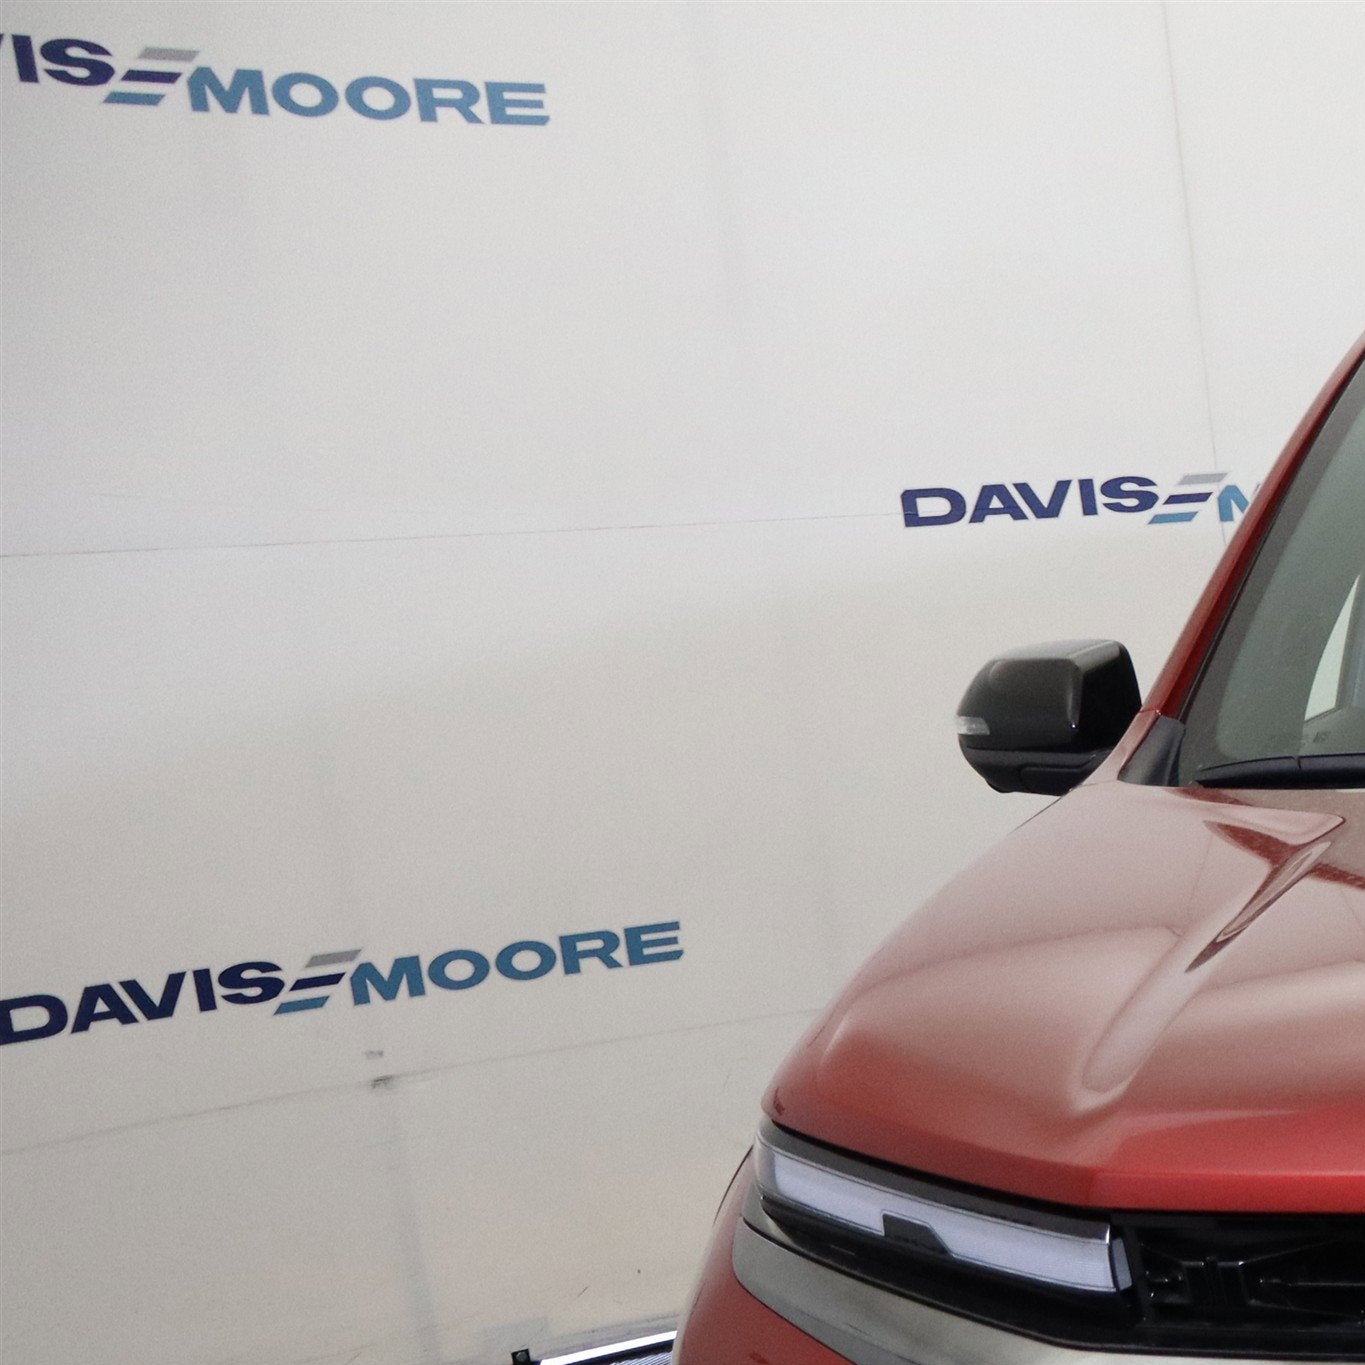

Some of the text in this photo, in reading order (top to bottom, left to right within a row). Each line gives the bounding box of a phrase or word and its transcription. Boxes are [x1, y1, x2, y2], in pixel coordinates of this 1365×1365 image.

[186, 65, 550, 126] MOORE
[899, 475, 1160, 528] DAVIS
[0, 920, 685, 1047] DAVIS MOORE
